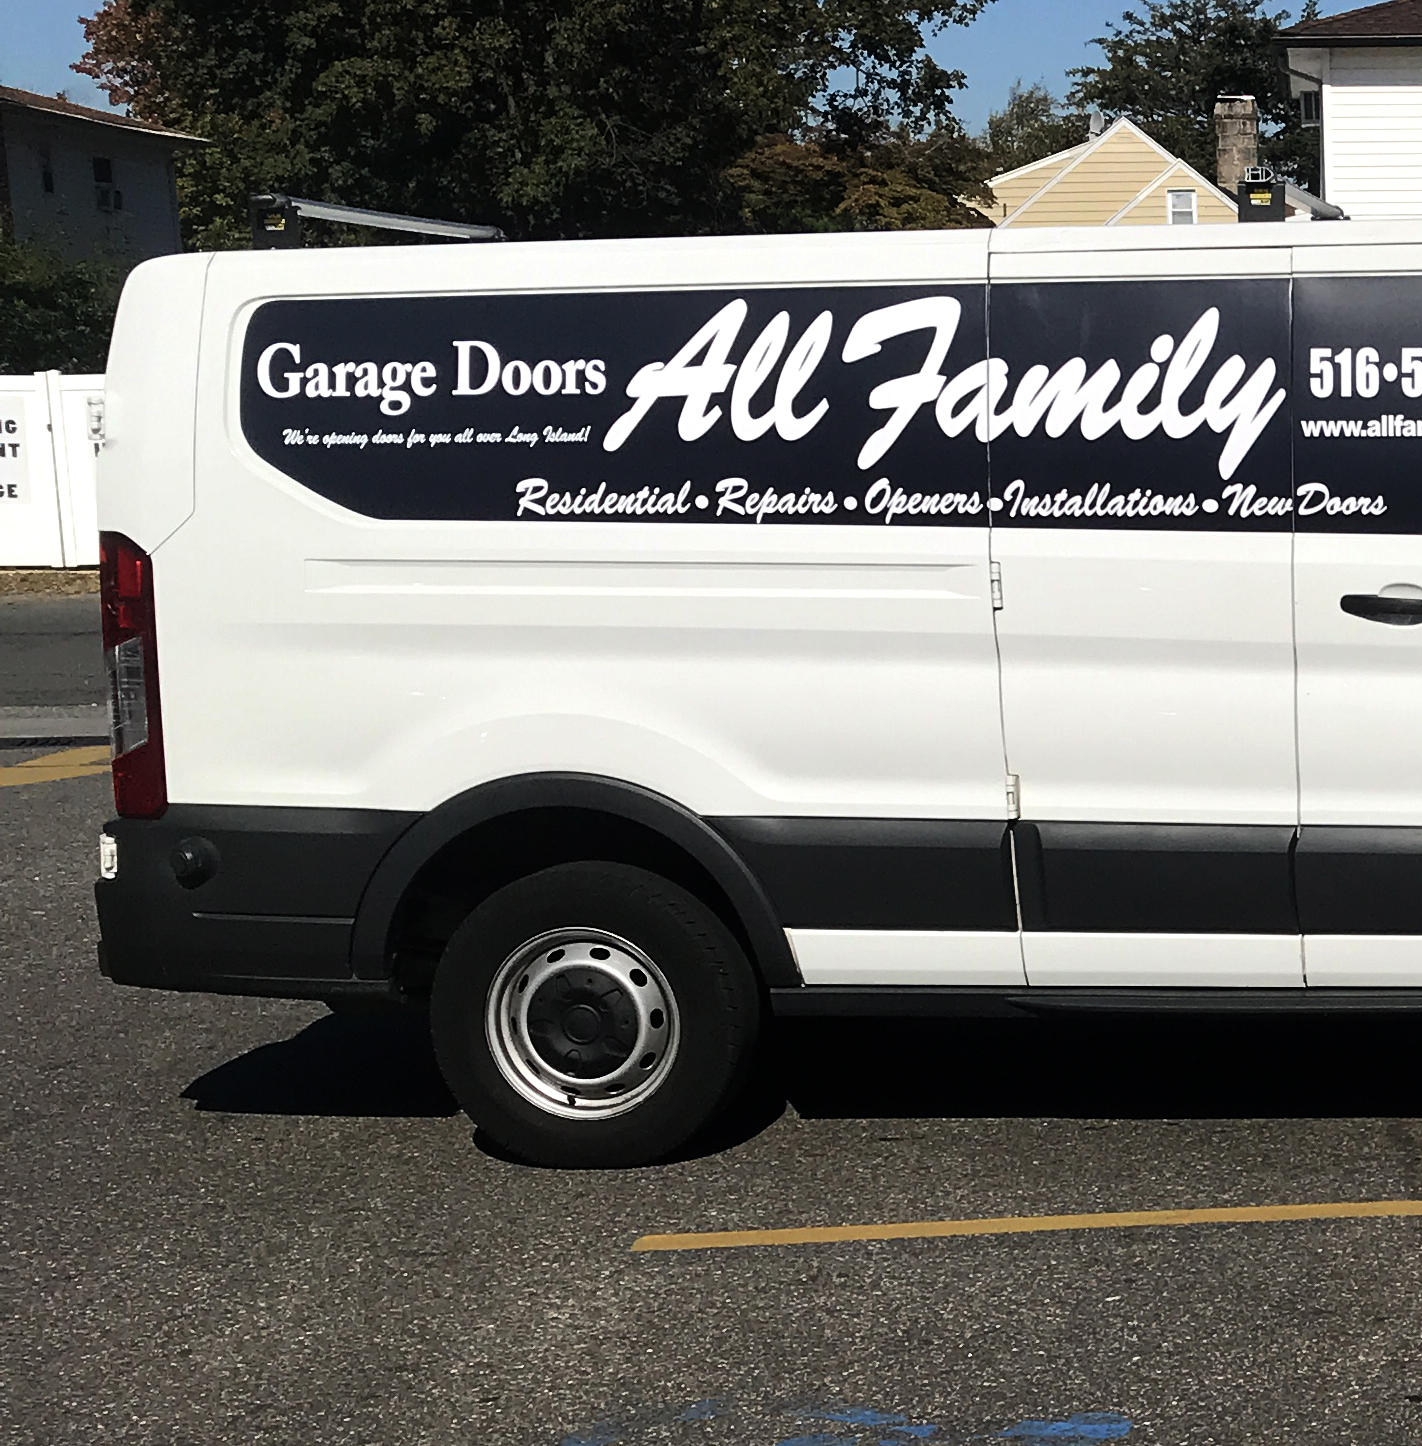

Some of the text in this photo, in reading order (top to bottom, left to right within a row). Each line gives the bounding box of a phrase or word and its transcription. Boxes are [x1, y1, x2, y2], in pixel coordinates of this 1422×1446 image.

[256, 340, 607, 416] Garage Doors
[602, 295, 1287, 481] All Family
[282, 425, 592, 450] We're opening doors for you all over Long Island!
[515, 477, 1388, 525] Residential Repairs Openers Installations New Doors
